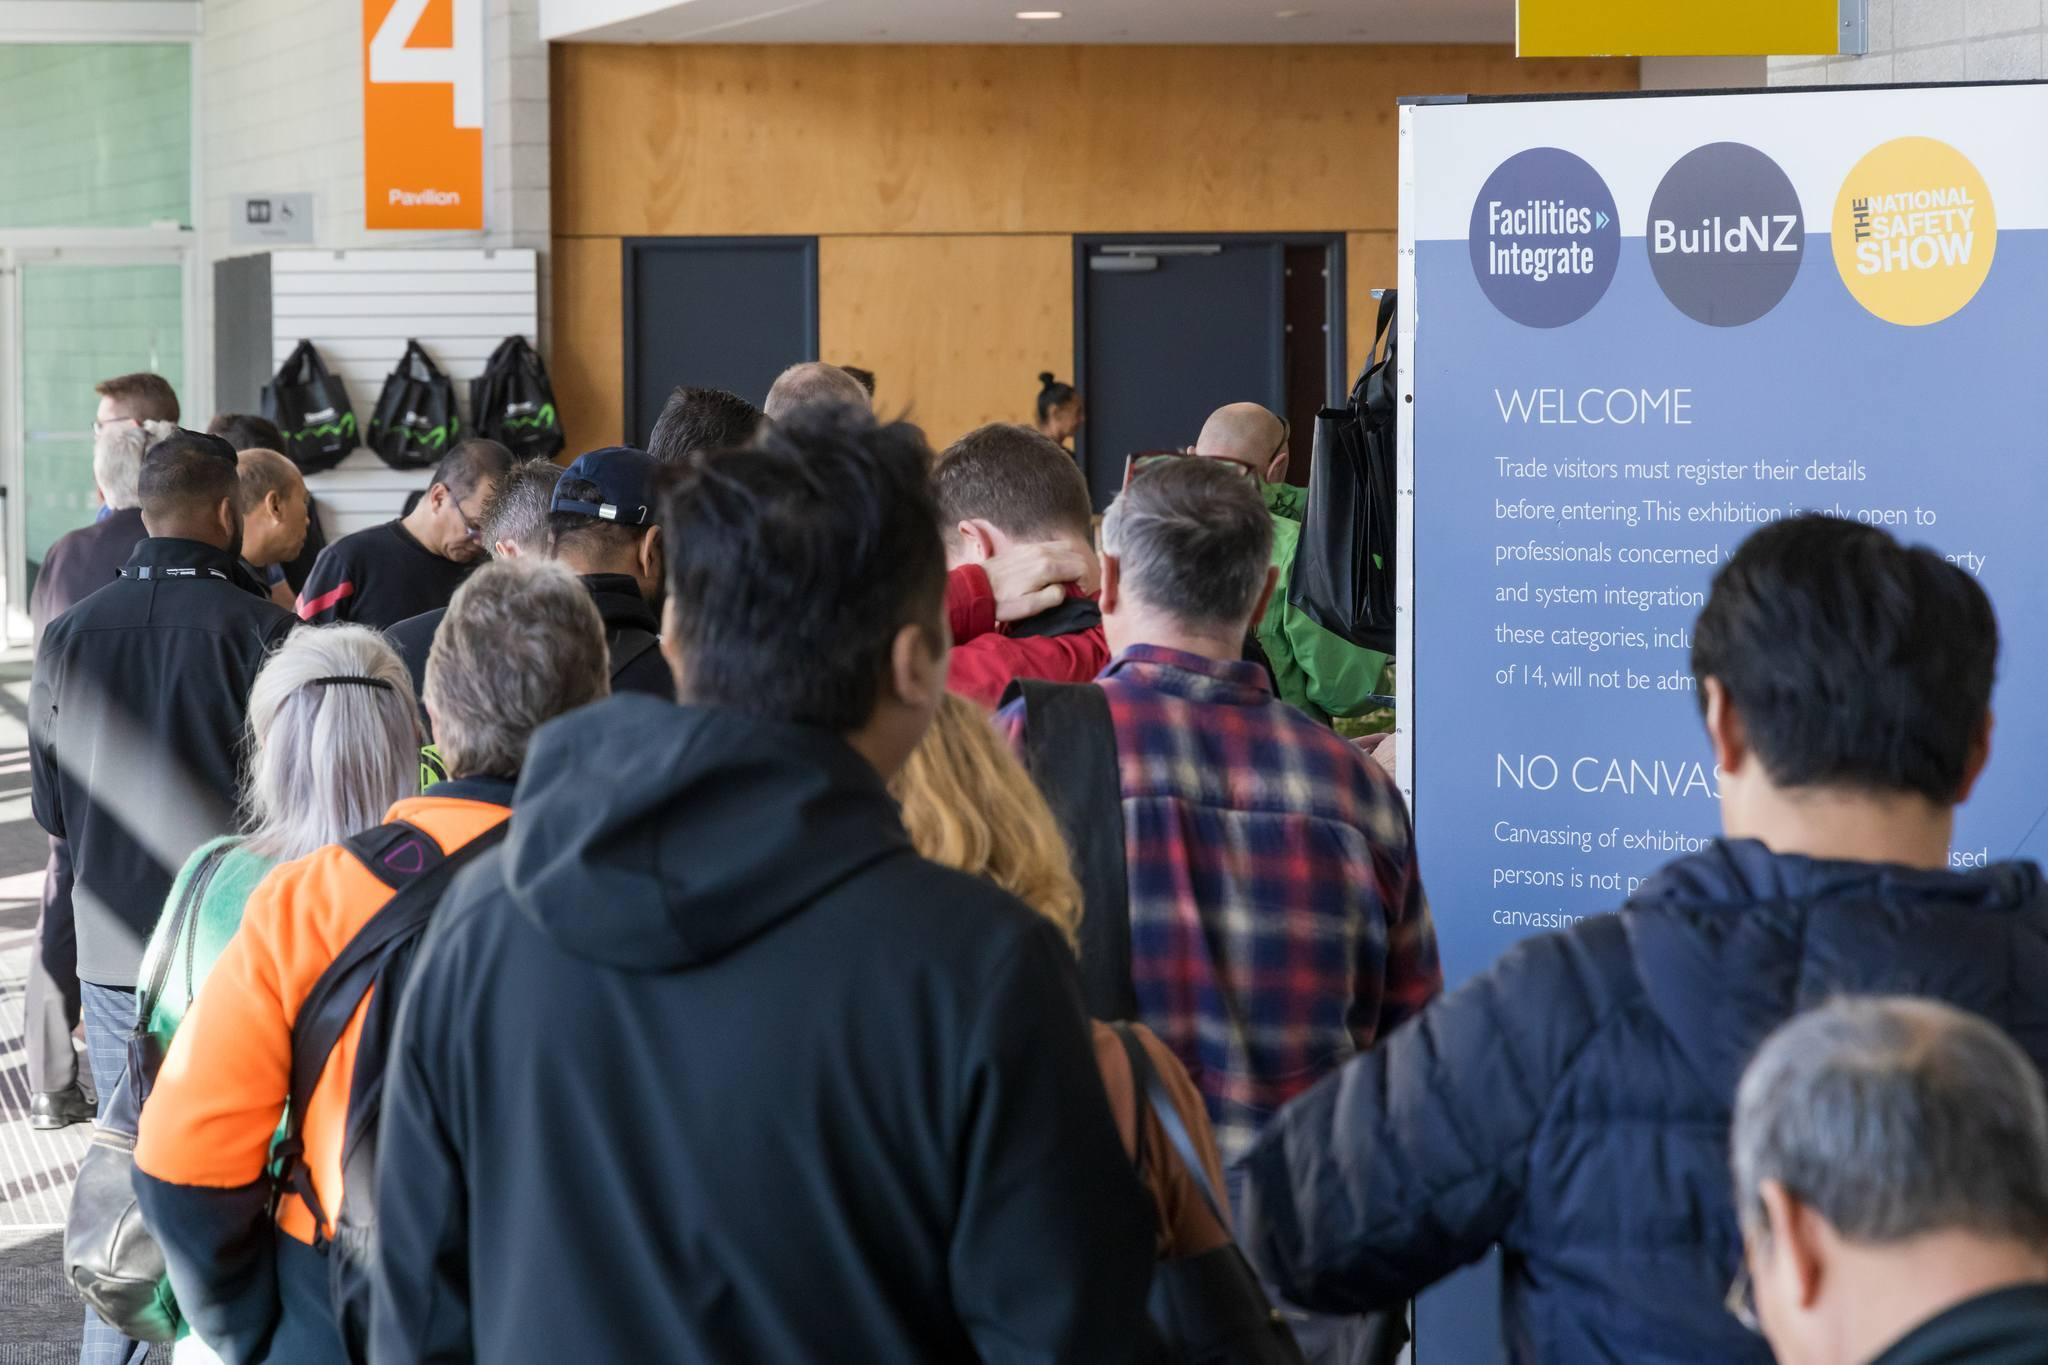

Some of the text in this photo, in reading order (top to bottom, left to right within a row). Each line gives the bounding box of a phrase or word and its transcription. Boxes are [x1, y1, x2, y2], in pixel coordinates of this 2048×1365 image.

[370, 0, 483, 128] 4
[388, 188, 460, 206] Pavilion
[1868, 186, 1975, 216] NATIONAL
[1489, 200, 1592, 235] Facilities
[1852, 197, 1871, 243] THE
[1871, 207, 1974, 240] SAFETY
[1654, 215, 1798, 254] BuildNZ
[1489, 240, 1594, 282] Integrate
[1855, 231, 1974, 275] SHOW
[1495, 388, 1692, 424] WELCOME
[1495, 457, 1866, 485] Trade visitors must register their details
[1496, 498, 1555, 519] before
[1642, 500, 1680, 521] This
[1687, 501, 1781, 523] exhibition
[1856, 508, 1908, 527] open
[1913, 505, 1937, 526] to
[1496, 540, 1611, 566] professionals
[1619, 544, 1721, 566] concerned
[1496, 582, 1706, 611] and system integration
[1495, 623, 1544, 644] these
[1552, 626, 1648, 652] categories,
[1496, 664, 1516, 684] of
[1552, 666, 1581, 686] will
[1589, 671, 1620, 688] not
[1627, 668, 1650, 689] be
[1497, 753, 1558, 790] NO
[1495, 821, 1592, 852] Canvassing
[1599, 828, 1619, 848] of
[1623, 829, 1711, 853] exhibitor
[1494, 869, 1564, 888] persons
[1571, 867, 1583, 887] is
[1590, 873, 1621, 890] not
